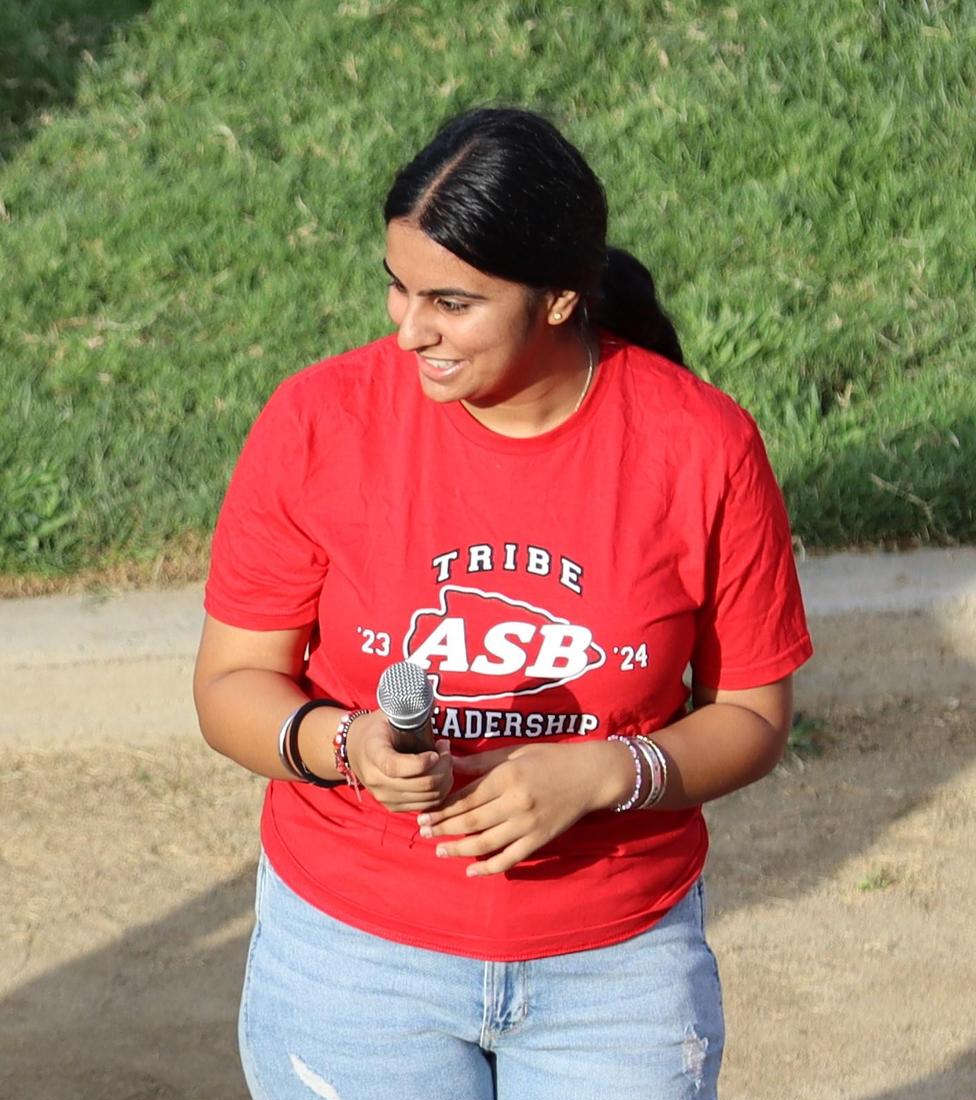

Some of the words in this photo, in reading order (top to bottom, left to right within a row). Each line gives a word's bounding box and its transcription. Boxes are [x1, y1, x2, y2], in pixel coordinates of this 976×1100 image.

[432, 542, 584, 595] TRIBE
[407, 617, 592, 679] ASB
[612, 642, 649, 672] '24
[430, 705, 599, 739] ADERSHIP
